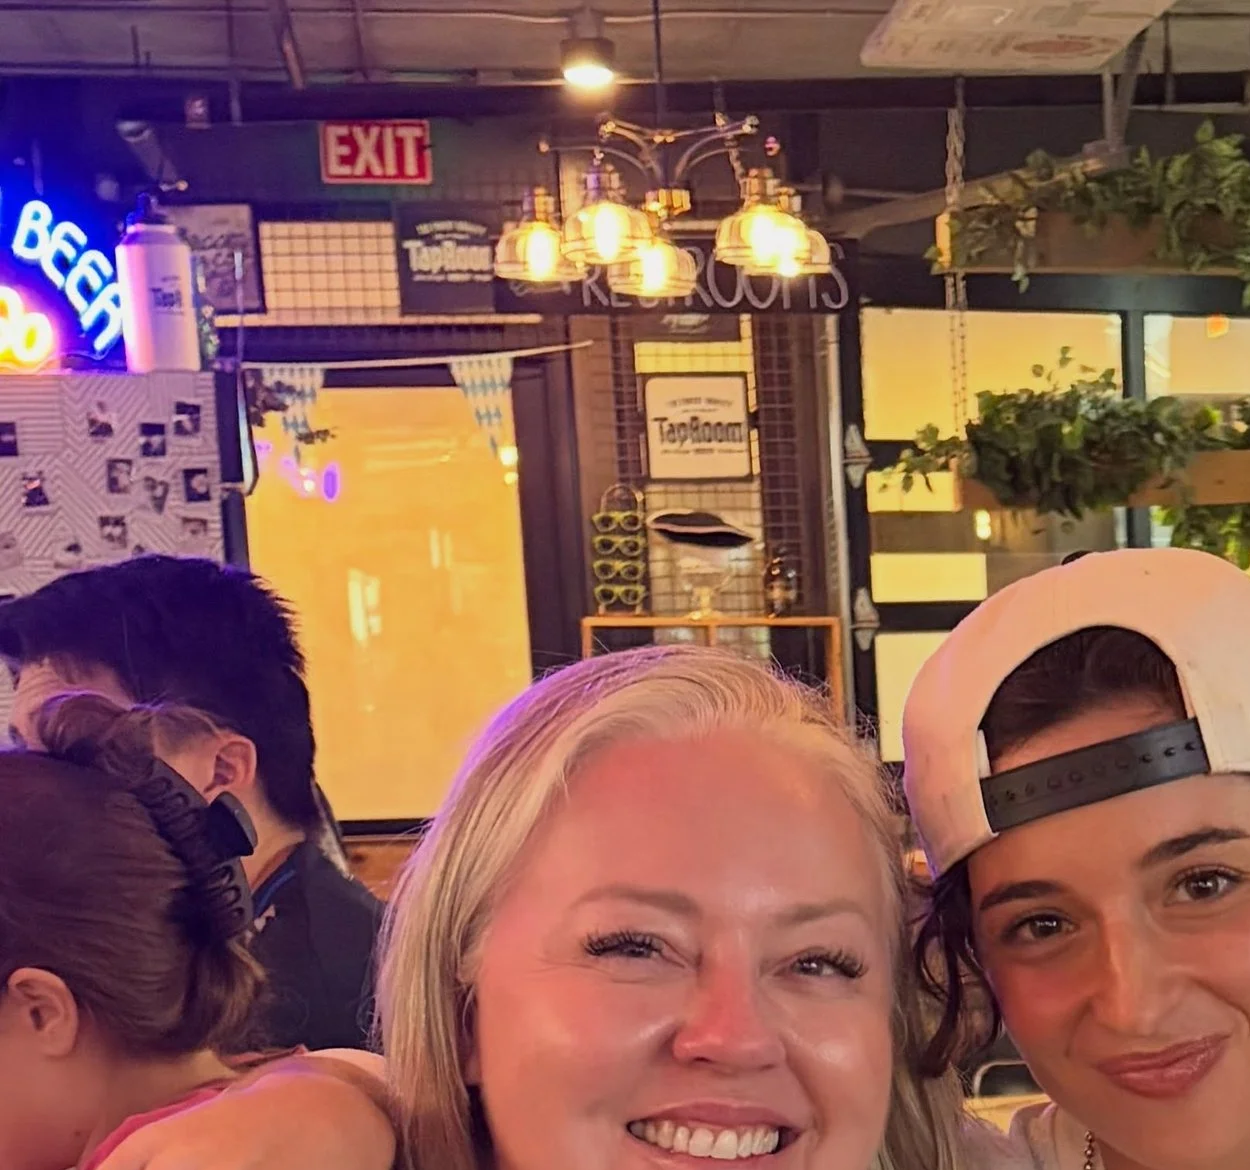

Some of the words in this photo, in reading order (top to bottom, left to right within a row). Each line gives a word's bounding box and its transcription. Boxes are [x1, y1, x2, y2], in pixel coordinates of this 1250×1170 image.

[325, 125, 424, 177] EXIT
[12, 199, 123, 351] BEER
[652, 416, 743, 447] TapRoom
